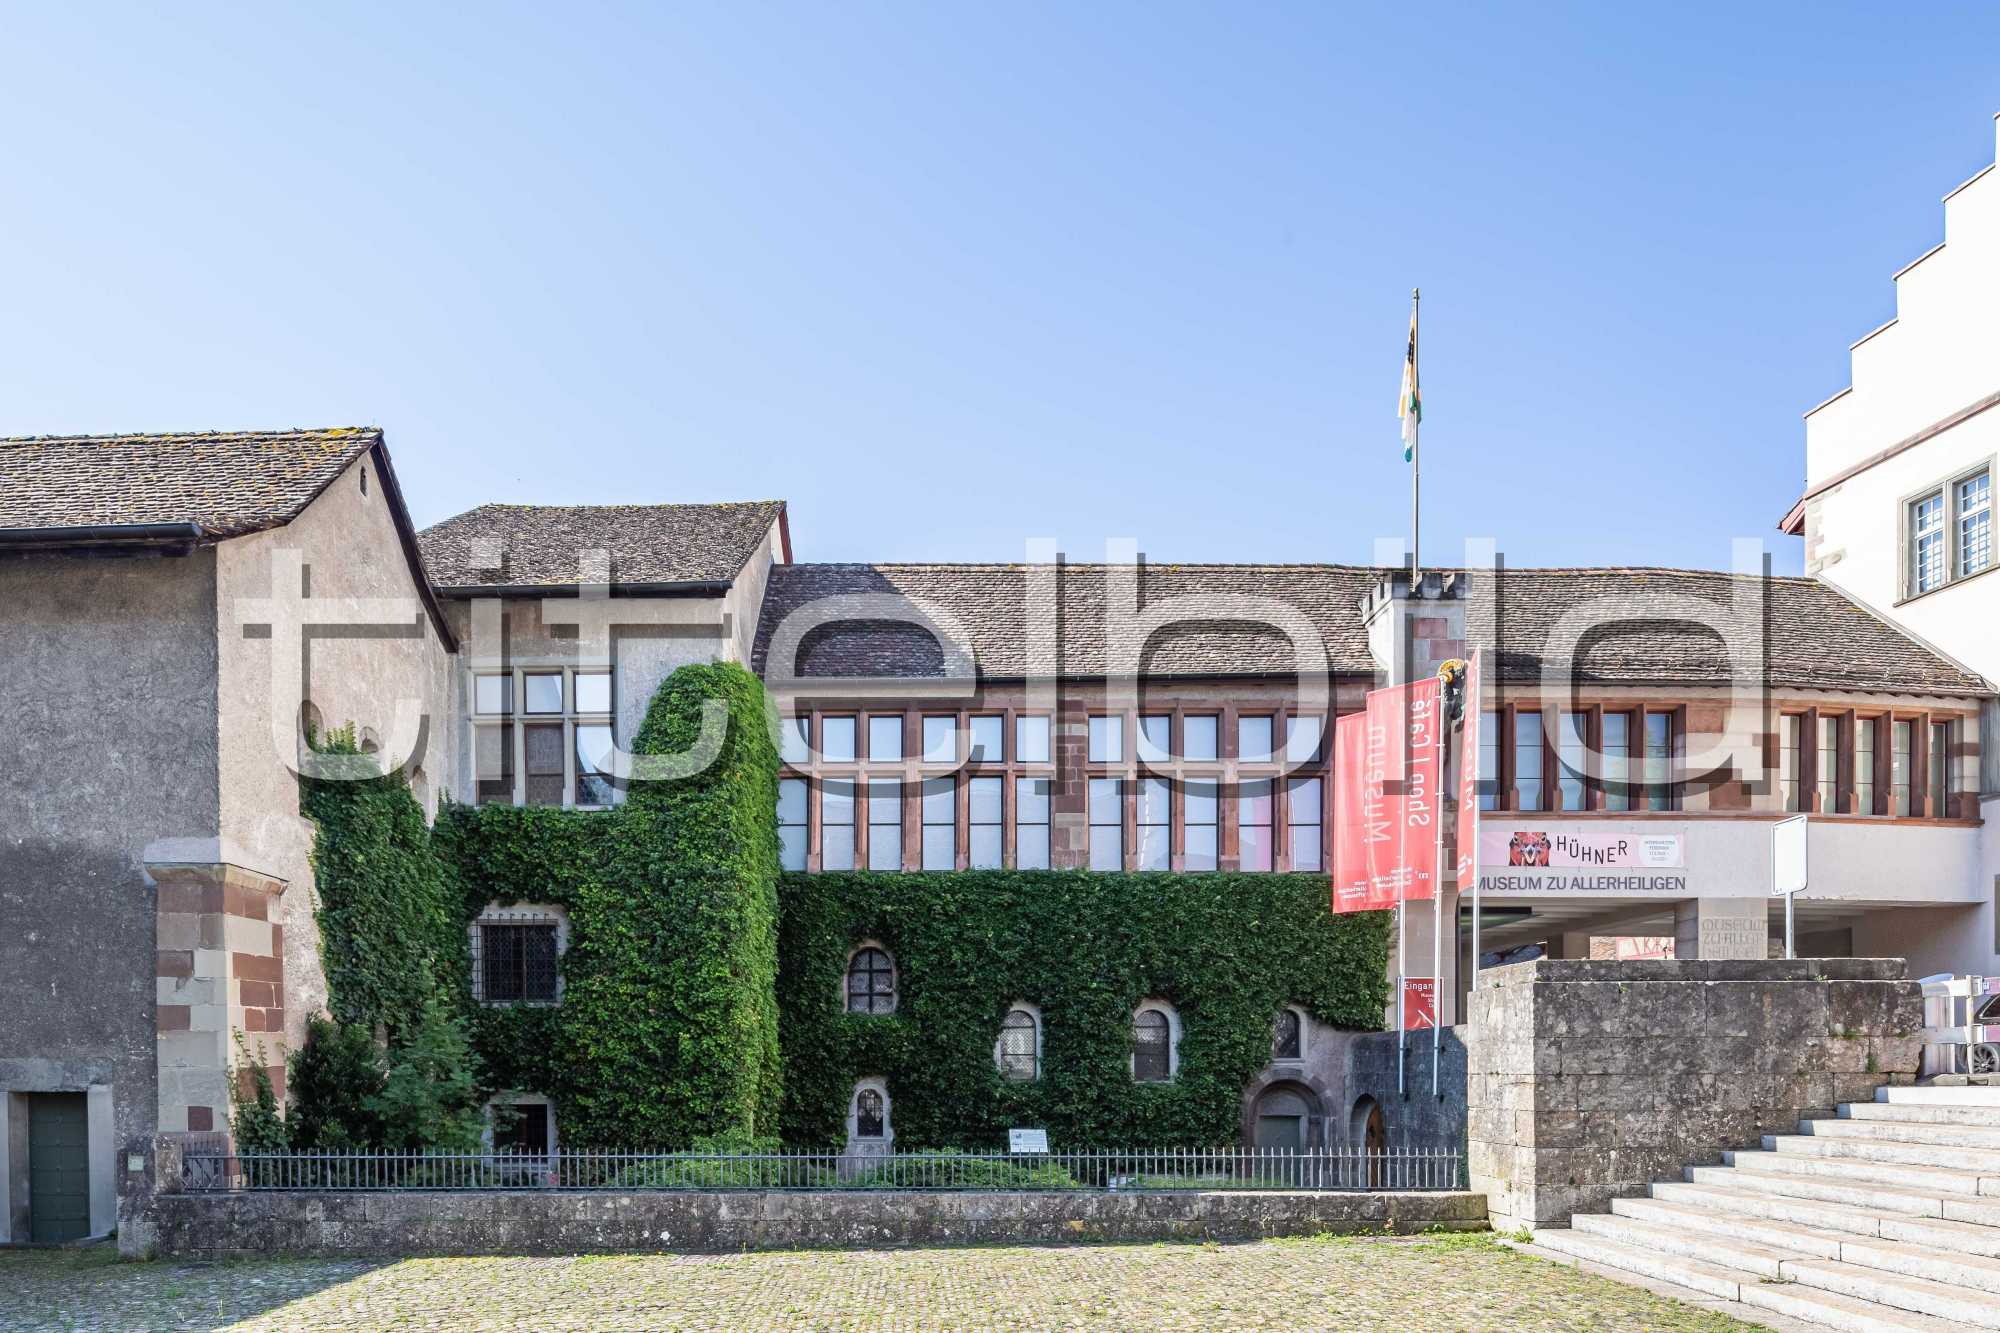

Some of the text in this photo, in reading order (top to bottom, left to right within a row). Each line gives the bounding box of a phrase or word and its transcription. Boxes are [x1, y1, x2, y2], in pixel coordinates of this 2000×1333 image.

[1557, 836, 1627, 864] HÜHNER
[1476, 876, 1686, 890] MUSEUM ZU ALLERHEILIGEN
[1403, 981, 1436, 992] Eingan
